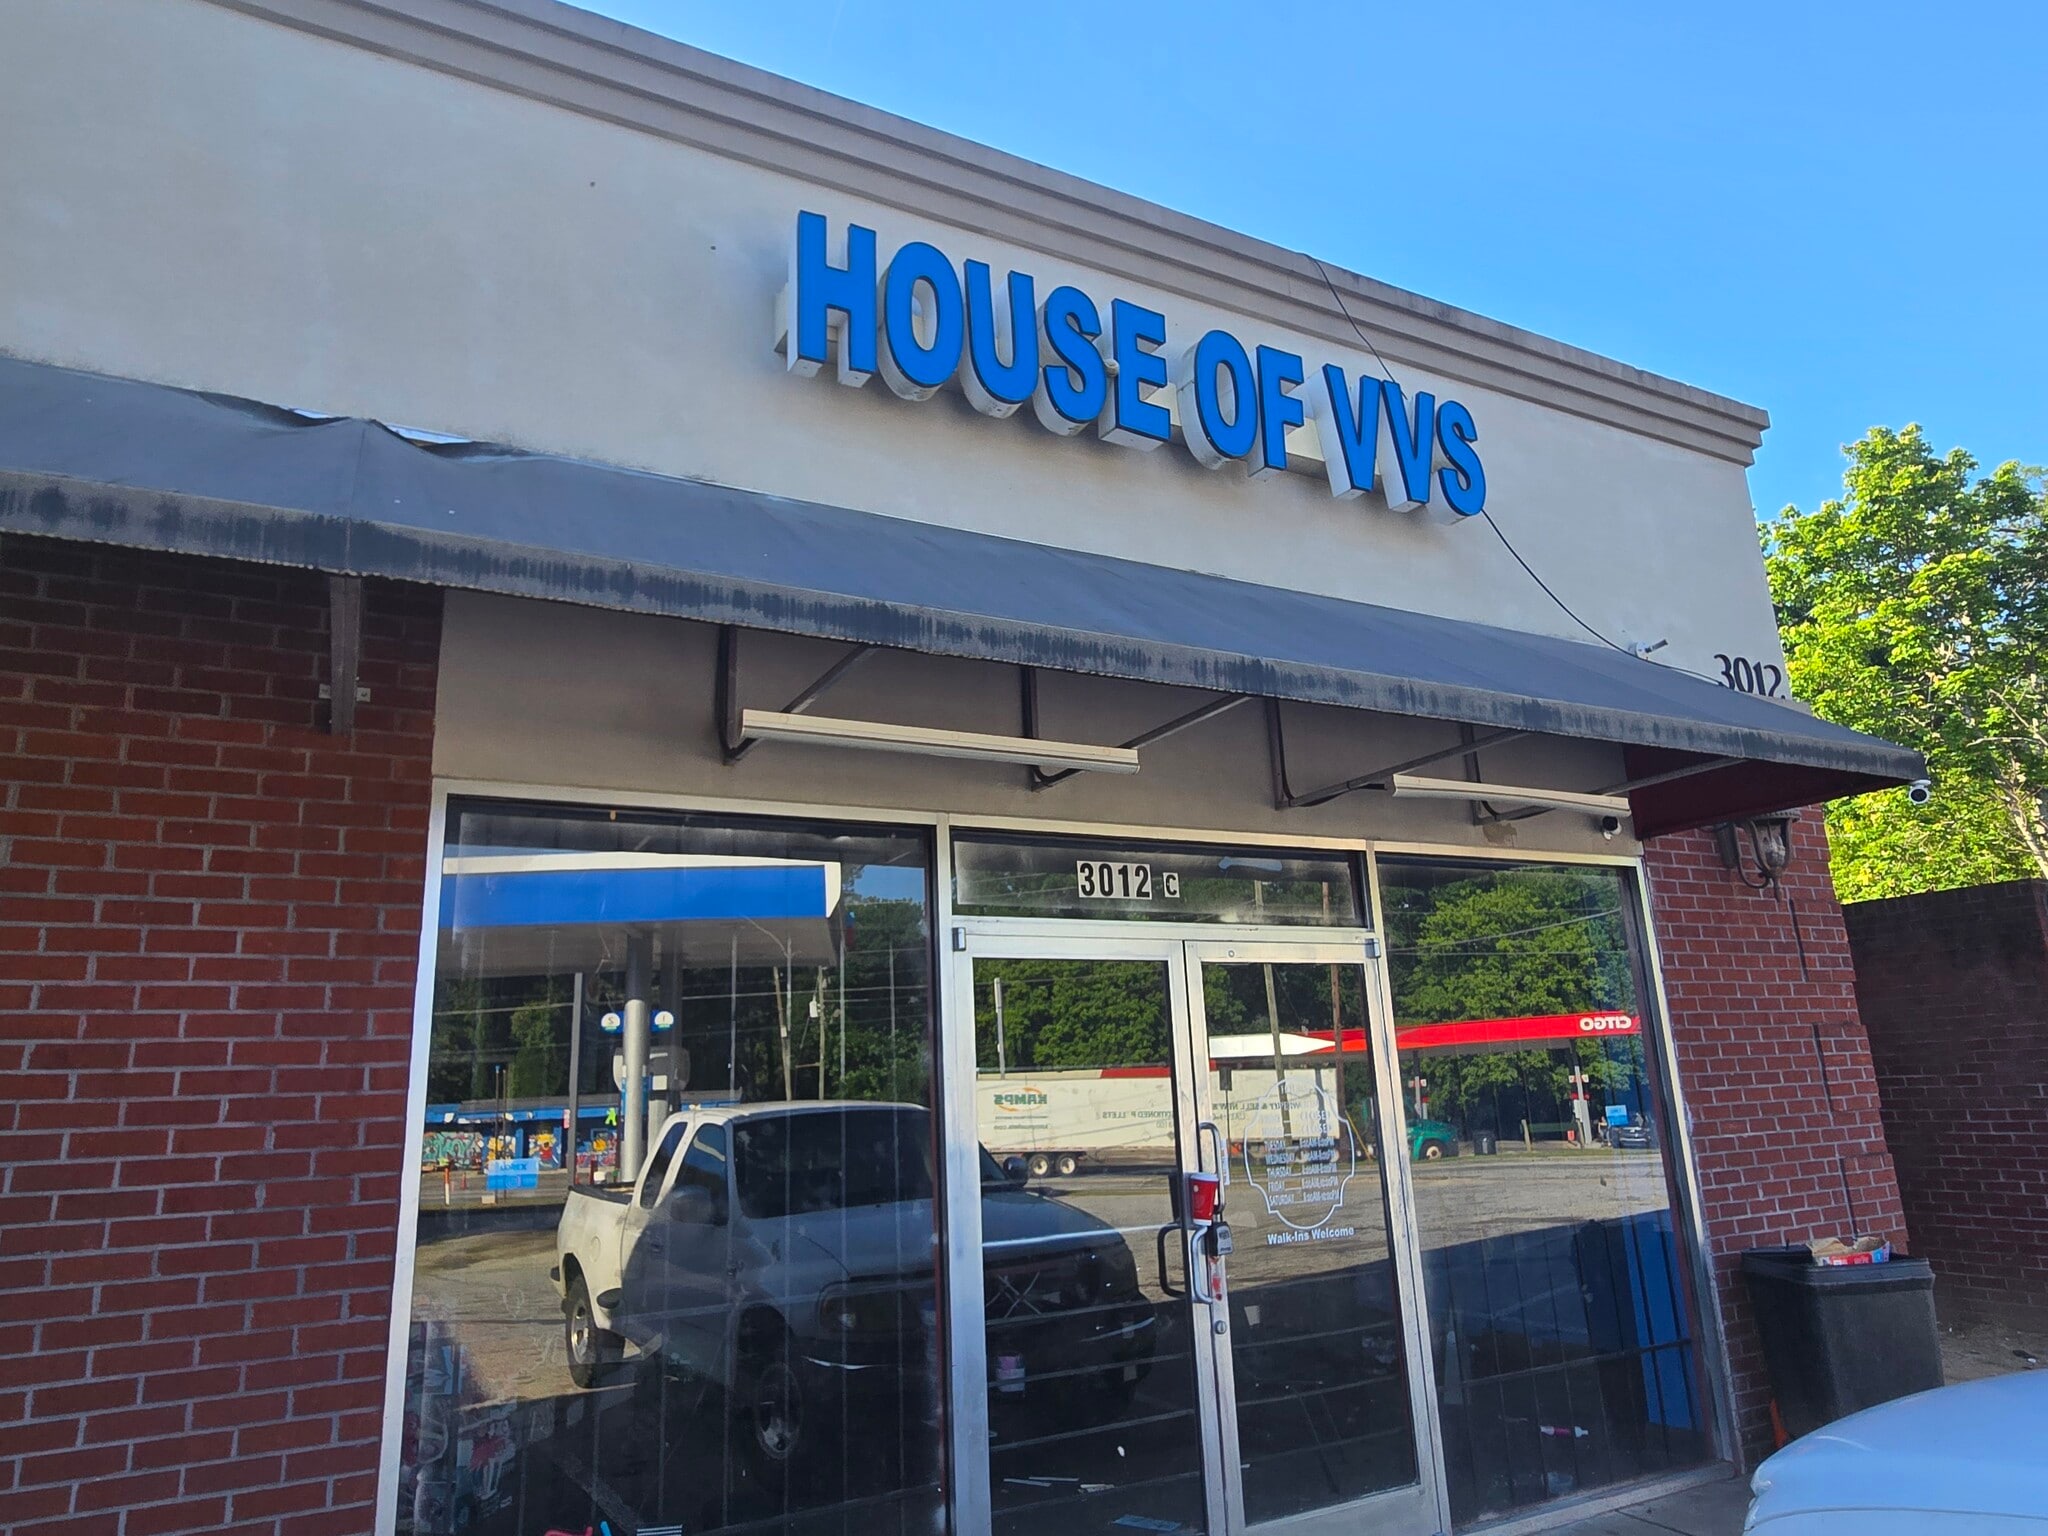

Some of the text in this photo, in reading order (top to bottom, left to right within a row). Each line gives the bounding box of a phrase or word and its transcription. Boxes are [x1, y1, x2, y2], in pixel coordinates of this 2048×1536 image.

[798, 210, 1487, 517] HOUSE OF VVS
[1714, 653, 1785, 699] 3012
[1079, 862, 1178, 898] 3012 C
[1267, 1226, 1355, 1245] Walk-Ins Welcome
